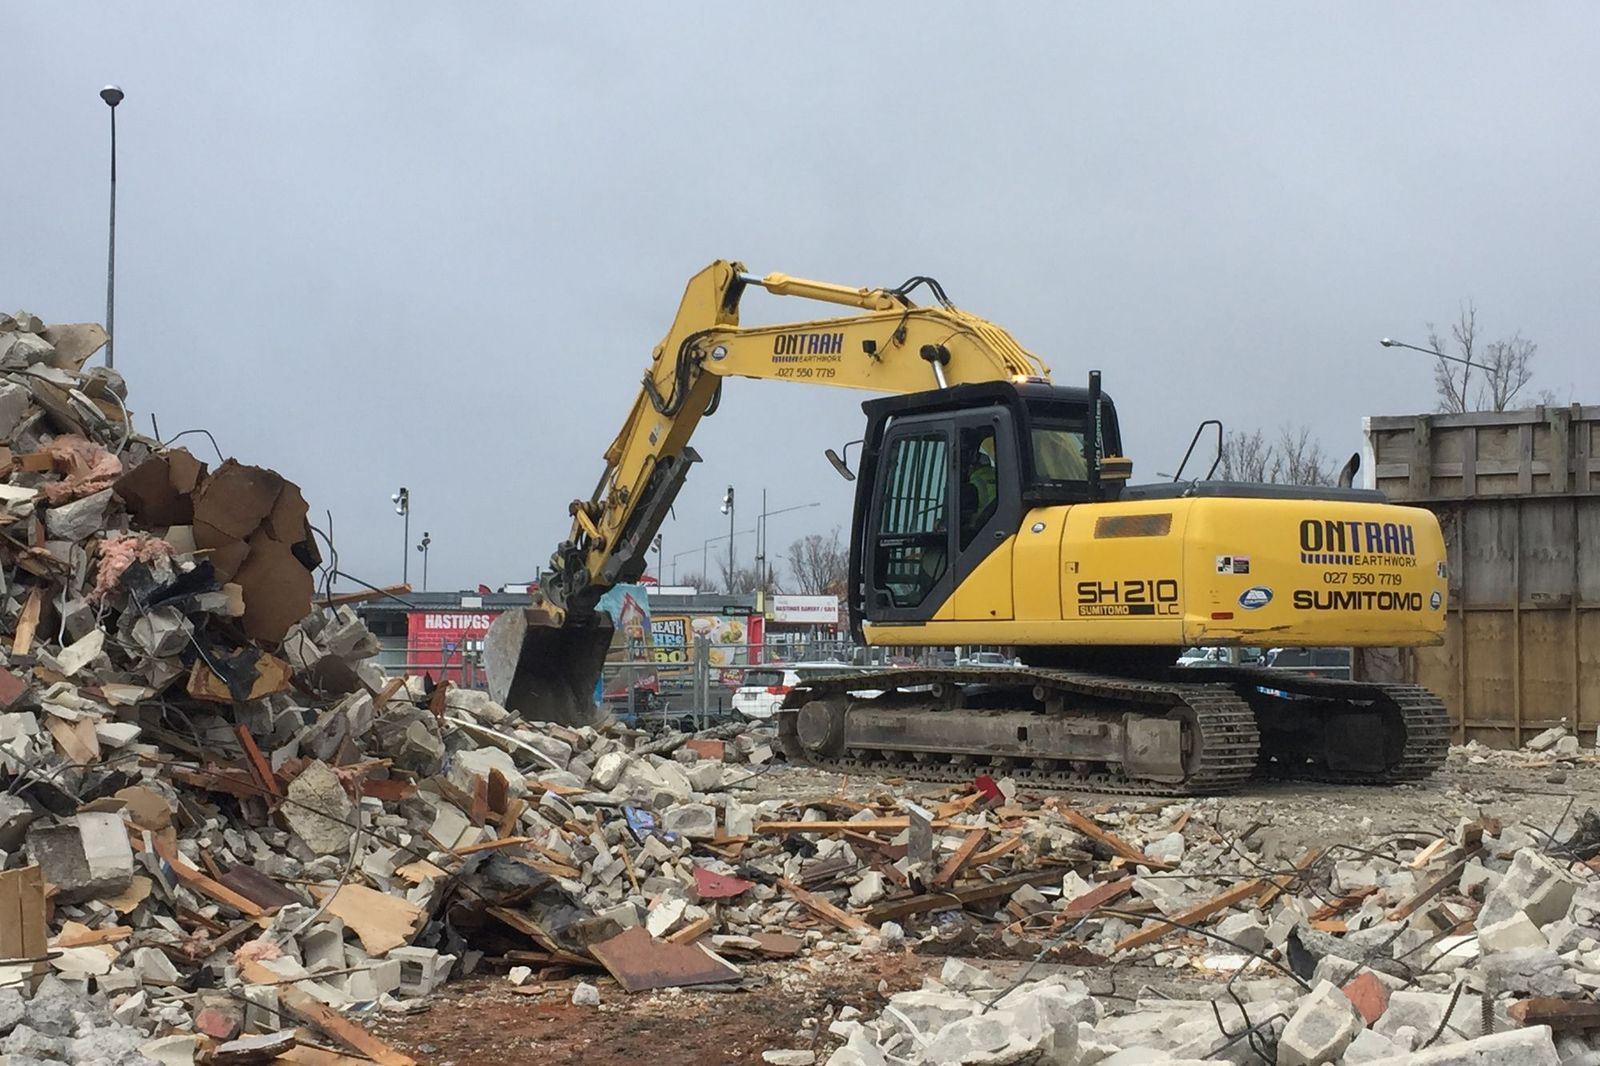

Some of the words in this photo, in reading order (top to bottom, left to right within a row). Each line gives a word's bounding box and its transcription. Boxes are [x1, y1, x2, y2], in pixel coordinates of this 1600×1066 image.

[778, 368, 794, 377] 027
[797, 368, 813, 377] 550
[816, 368, 836, 377] 7719
[1354, 554, 1417, 567] EARTHWORX
[1323, 571, 1347, 584] 027
[1352, 573, 1375, 585] 550
[1379, 573, 1402, 586] 7719
[1293, 590, 1423, 611] SUMITOMO
[1080, 605, 1130, 615] SUMITOMO
[1158, 603, 1179, 615] LC
[425, 614, 490, 629] HASTINGS
